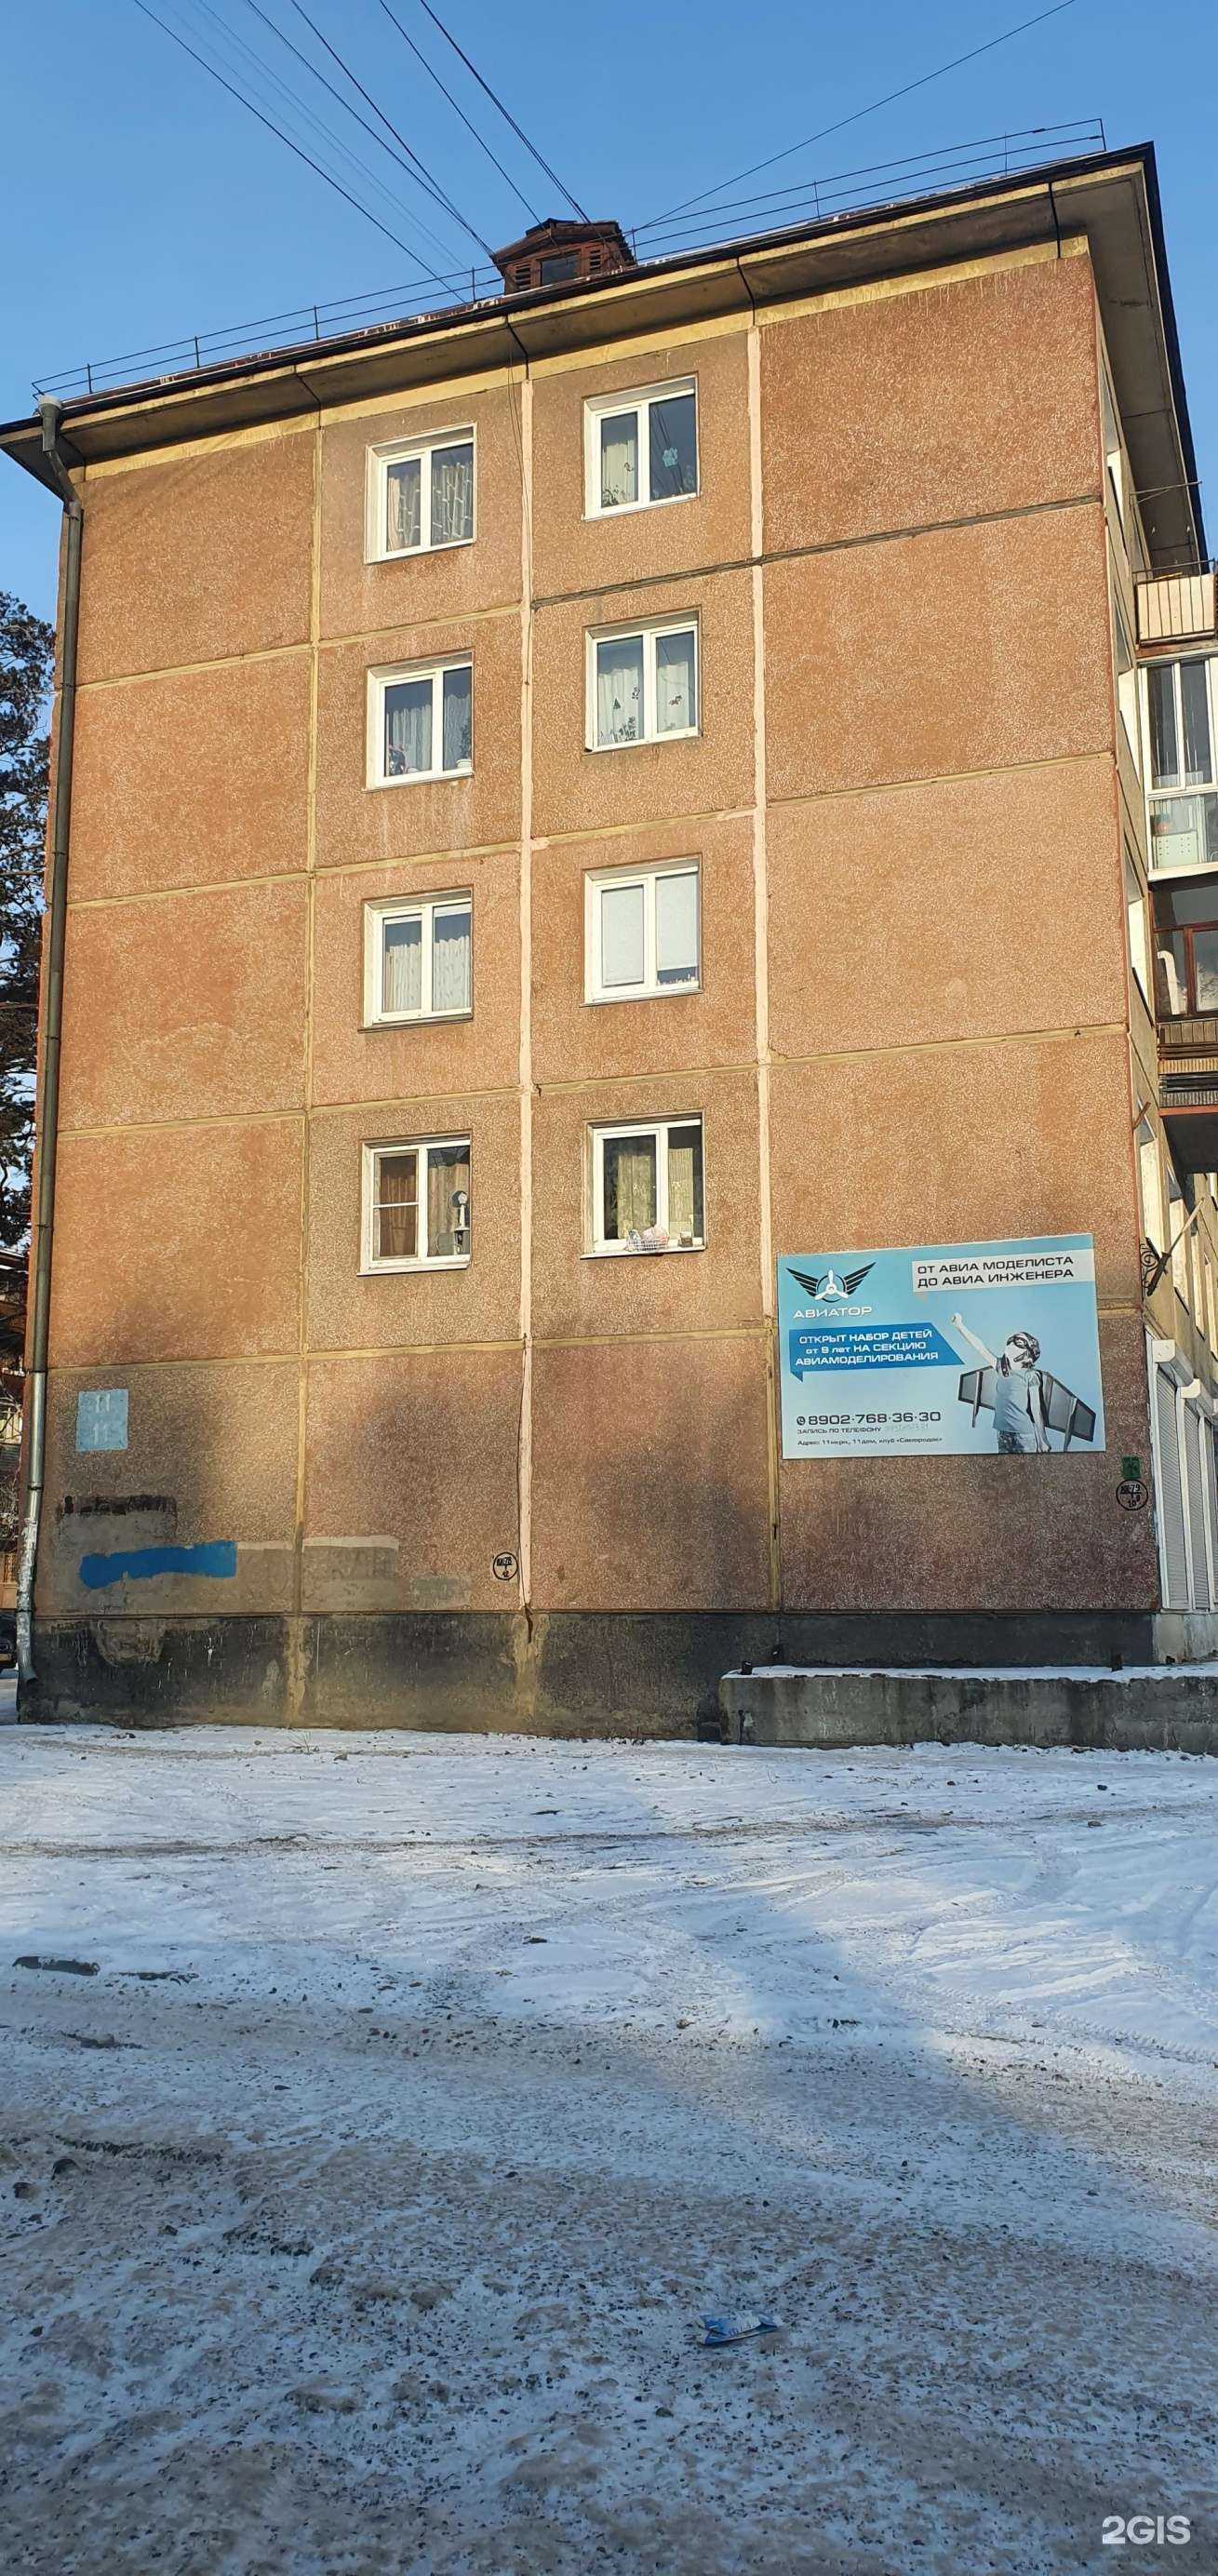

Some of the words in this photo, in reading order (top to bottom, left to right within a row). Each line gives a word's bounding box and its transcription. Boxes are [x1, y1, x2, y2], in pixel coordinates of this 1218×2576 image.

[917, 1265, 935, 1275] ОТ
[939, 1262, 979, 1273] АВИА
[983, 1256, 1074, 1271] МОДЕЛИСТА
[917, 1277, 938, 1289] ДО
[942, 1275, 984, 1286] АВИА
[988, 1268, 1074, 1282] ИНЖЕНЕРА
[793, 1306, 873, 1319] АВИАТОР
[798, 1334, 846, 1345] ОТКРЫТ
[849, 1331, 890, 1343] НАБОР
[891, 1328, 933, 1341] ДЕТЕЙ
[853, 1344, 870, 1352] НА
[873, 1341, 927, 1352] СЕКЦИЮ
[795, 1351, 939, 1367] АВИАМОДЕЛИРОВАНИЯ
[841, 1426, 882, 1434] ТЕЛЕФОНУ
